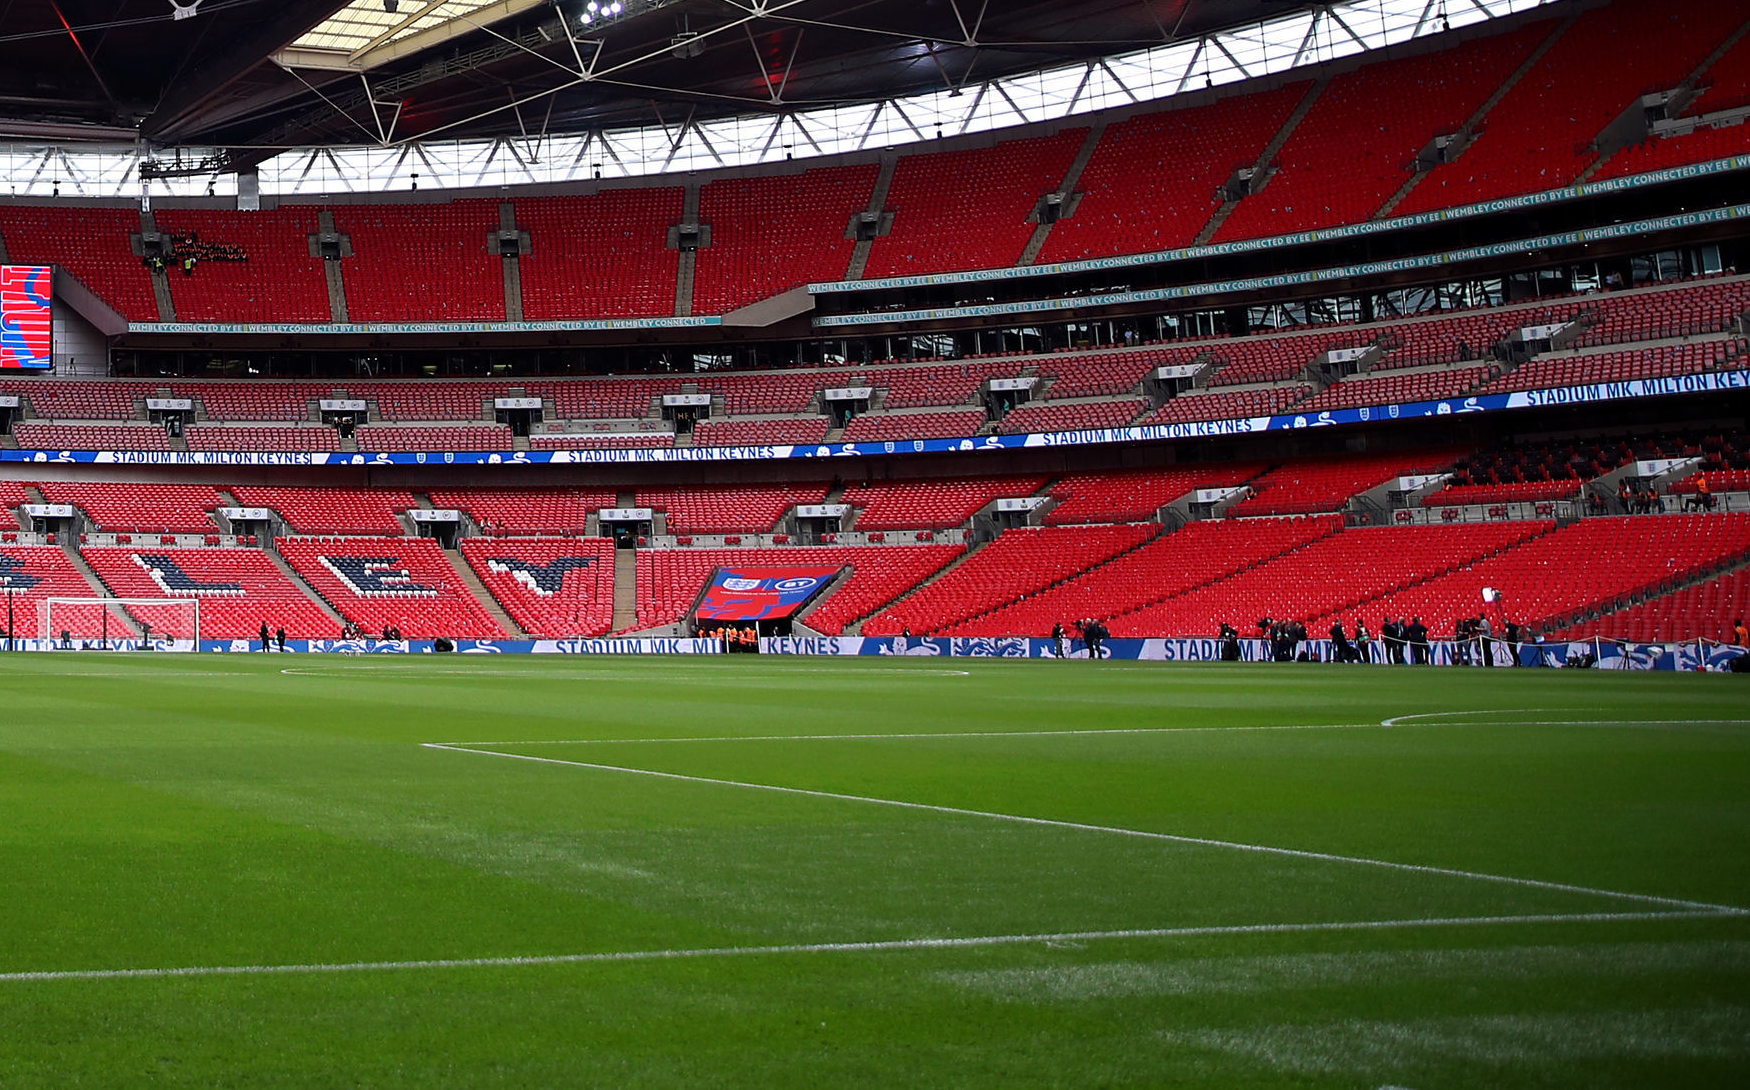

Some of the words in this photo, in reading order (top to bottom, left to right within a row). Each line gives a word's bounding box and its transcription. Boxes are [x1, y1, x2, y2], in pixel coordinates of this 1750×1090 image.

[1582, 176, 1631, 195] WEMBLEY
[1633, 164, 1696, 185] CONNECTED
[1445, 201, 1490, 219] WEMBLEY
[1491, 192, 1546, 211] CONNECTED
[1317, 224, 1360, 239] WEMBLEY
[1360, 215, 1414, 233] CONNECTED
[1584, 223, 1631, 240] WEMBLEY
[1634, 213, 1695, 232] CONNECTED
[1187, 243, 1230, 257] WEMBLEY
[1230, 235, 1283, 252] CONNECTED
[1449, 244, 1491, 261] WEMBLEY
[1493, 236, 1548, 254] CONNECTED
[1317, 264, 1361, 279] WEMBLEY
[1362, 257, 1415, 274] CONNECTED
[1188, 281, 1231, 295] WEMBLEY
[1232, 275, 1284, 290] CONNECTED
[1526, 385, 1599, 406] STADIUM
[1642, 375, 1707, 395] MILTON
[1042, 429, 1106, 446] STADIUM
[1140, 422, 1190, 439] MILTON
[1195, 418, 1251, 435] KEYNES
[112, 452, 170, 463] STADIUM
[203, 452, 252, 464] MILTON
[257, 452, 310, 464] KEYNES
[568, 450, 629, 462] STADIUM
[664, 447, 712, 460] MILTON
[719, 446, 774, 458] KEYNES
[556, 639, 642, 654] STADIUM
[768, 637, 840, 654] KEYNES
